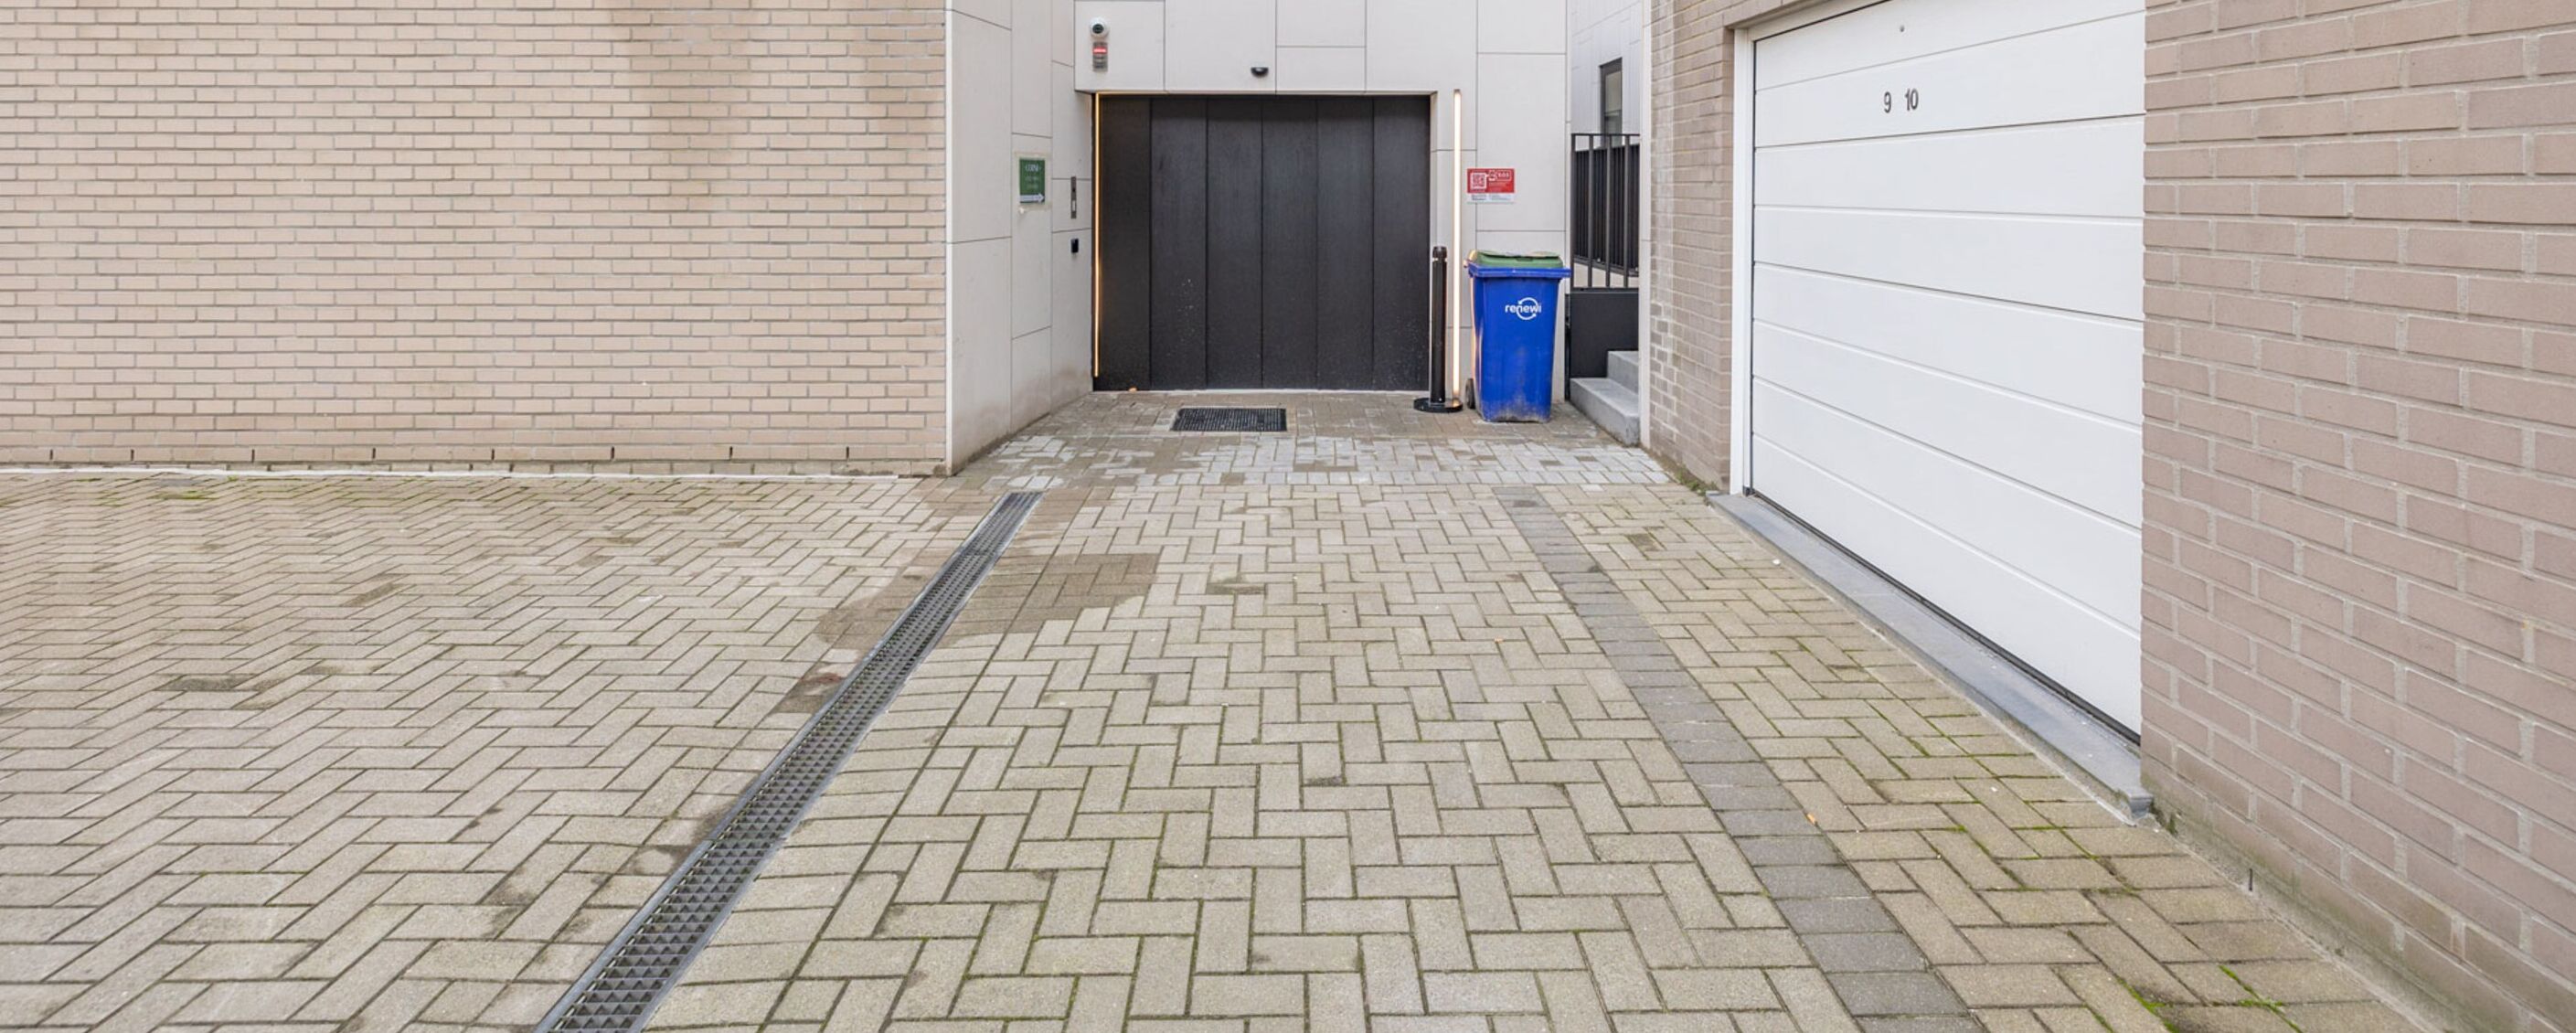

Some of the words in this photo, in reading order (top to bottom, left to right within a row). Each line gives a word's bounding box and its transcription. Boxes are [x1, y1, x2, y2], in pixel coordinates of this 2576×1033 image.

[1883, 91, 1892, 113] 9
[1904, 88, 1919, 112] 10
[1505, 301, 1543, 314] renewi
